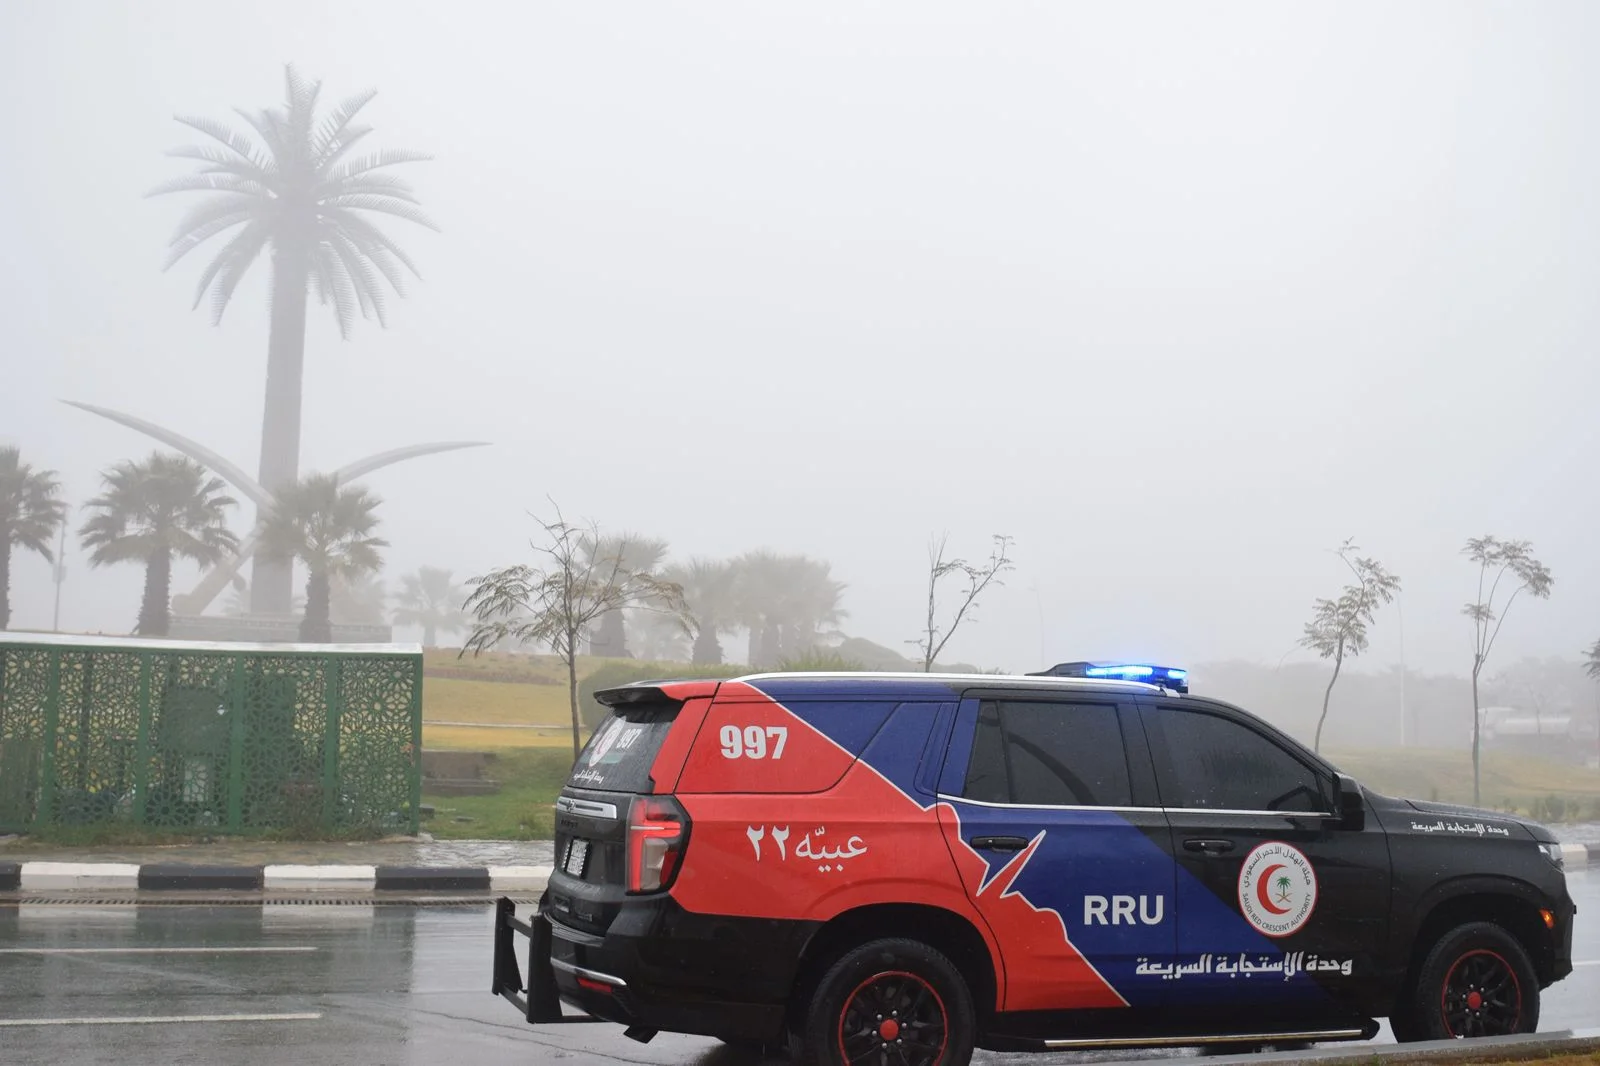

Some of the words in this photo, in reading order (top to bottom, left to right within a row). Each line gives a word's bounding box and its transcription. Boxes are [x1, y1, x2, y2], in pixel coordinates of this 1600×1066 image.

[720, 725, 788, 760] 997
[1410, 821, 1445, 832] السريعة
[1487, 825, 1509, 836] وحدة
[746, 824, 790, 862] ٢٢
[1083, 894, 1164, 926] RRU
[1243, 893, 1253, 914] SAUDI
[1250, 913, 1262, 925] RED
[1261, 922, 1290, 932] CRESCENT
[1290, 893, 1311, 927] AUTHORITY
[1135, 953, 1213, 980] السريعة
[1215, 951, 1304, 982] الإستجابة
[1305, 955, 1353, 976] وحدة
